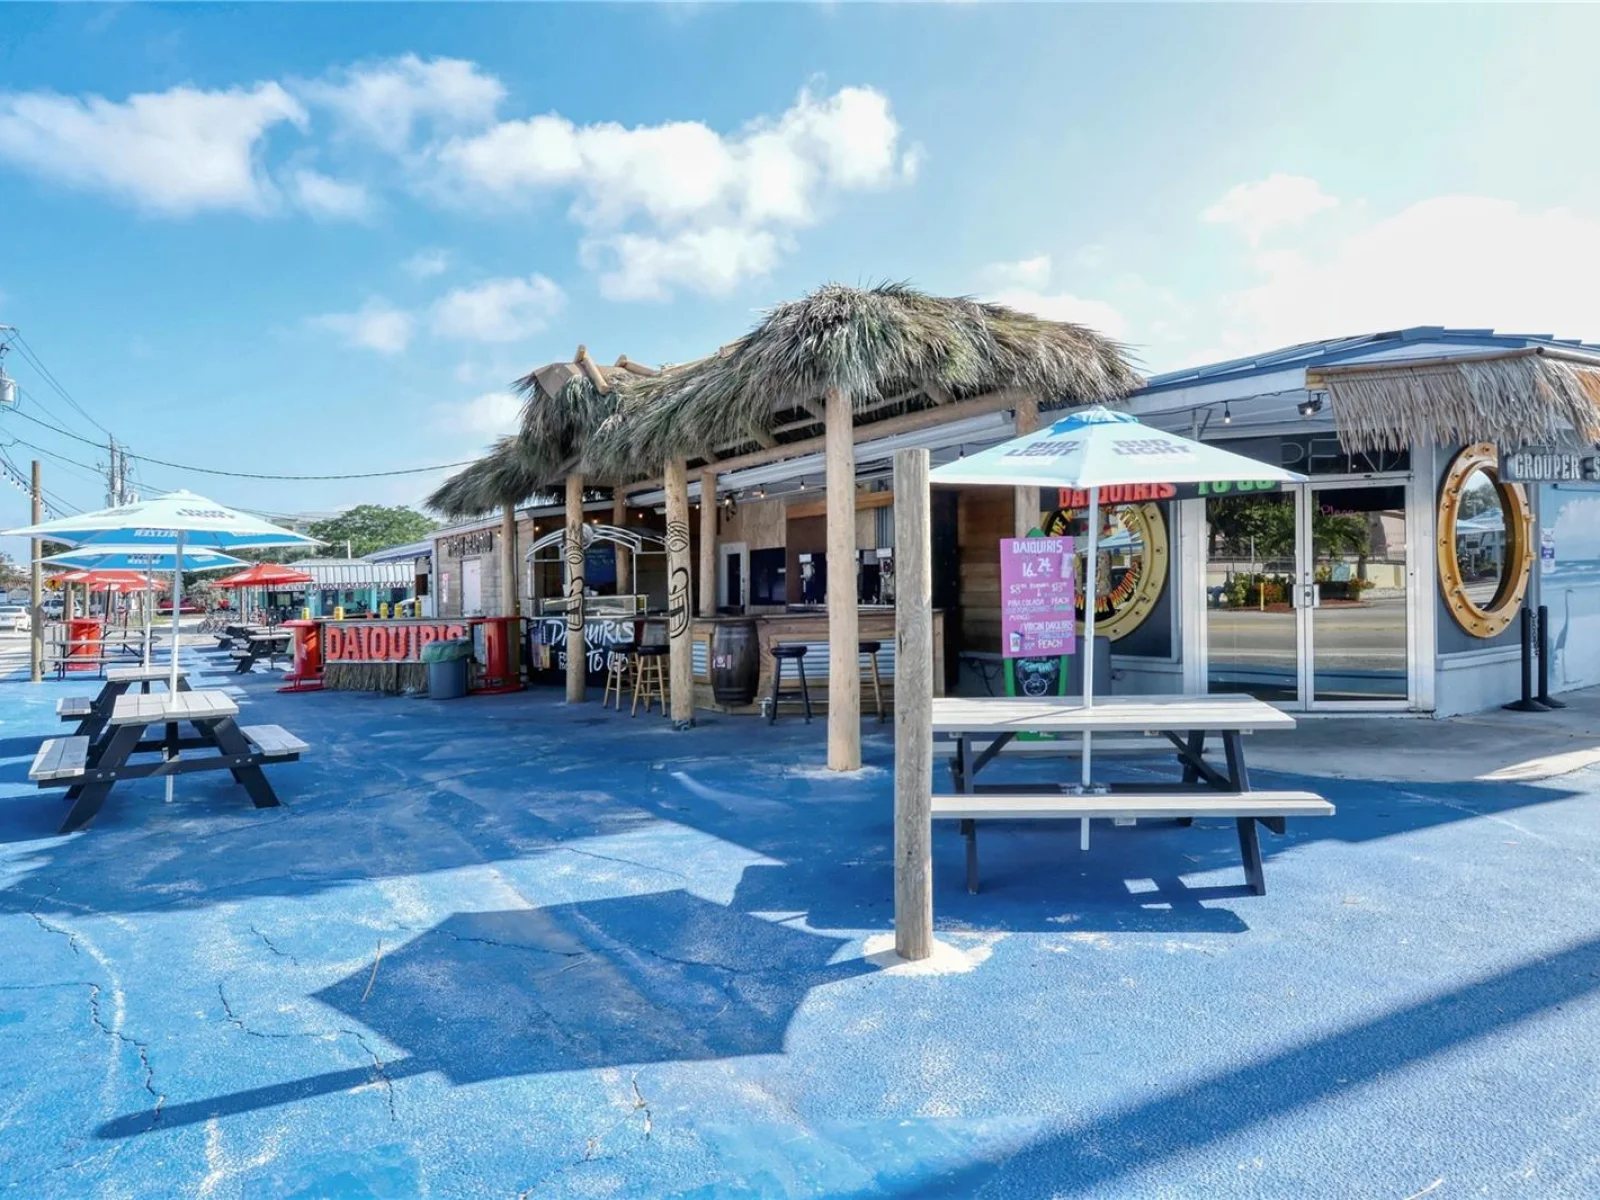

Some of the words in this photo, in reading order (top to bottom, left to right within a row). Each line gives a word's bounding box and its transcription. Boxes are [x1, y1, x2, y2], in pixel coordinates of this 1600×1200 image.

[1027, 441, 1080, 449] BUD
[1111, 440, 1173, 448] BUD
[1004, 448, 1080, 457] LIGHT
[1111, 446, 1193, 456] LIGHT
[1514, 453, 1580, 480] GROUPER
[1013, 540, 1063, 554] DAIQUIRIS
[545, 619, 636, 650] DUIRIS
[1038, 639, 1063, 649] PEACH
[586, 648, 604, 673] TO
